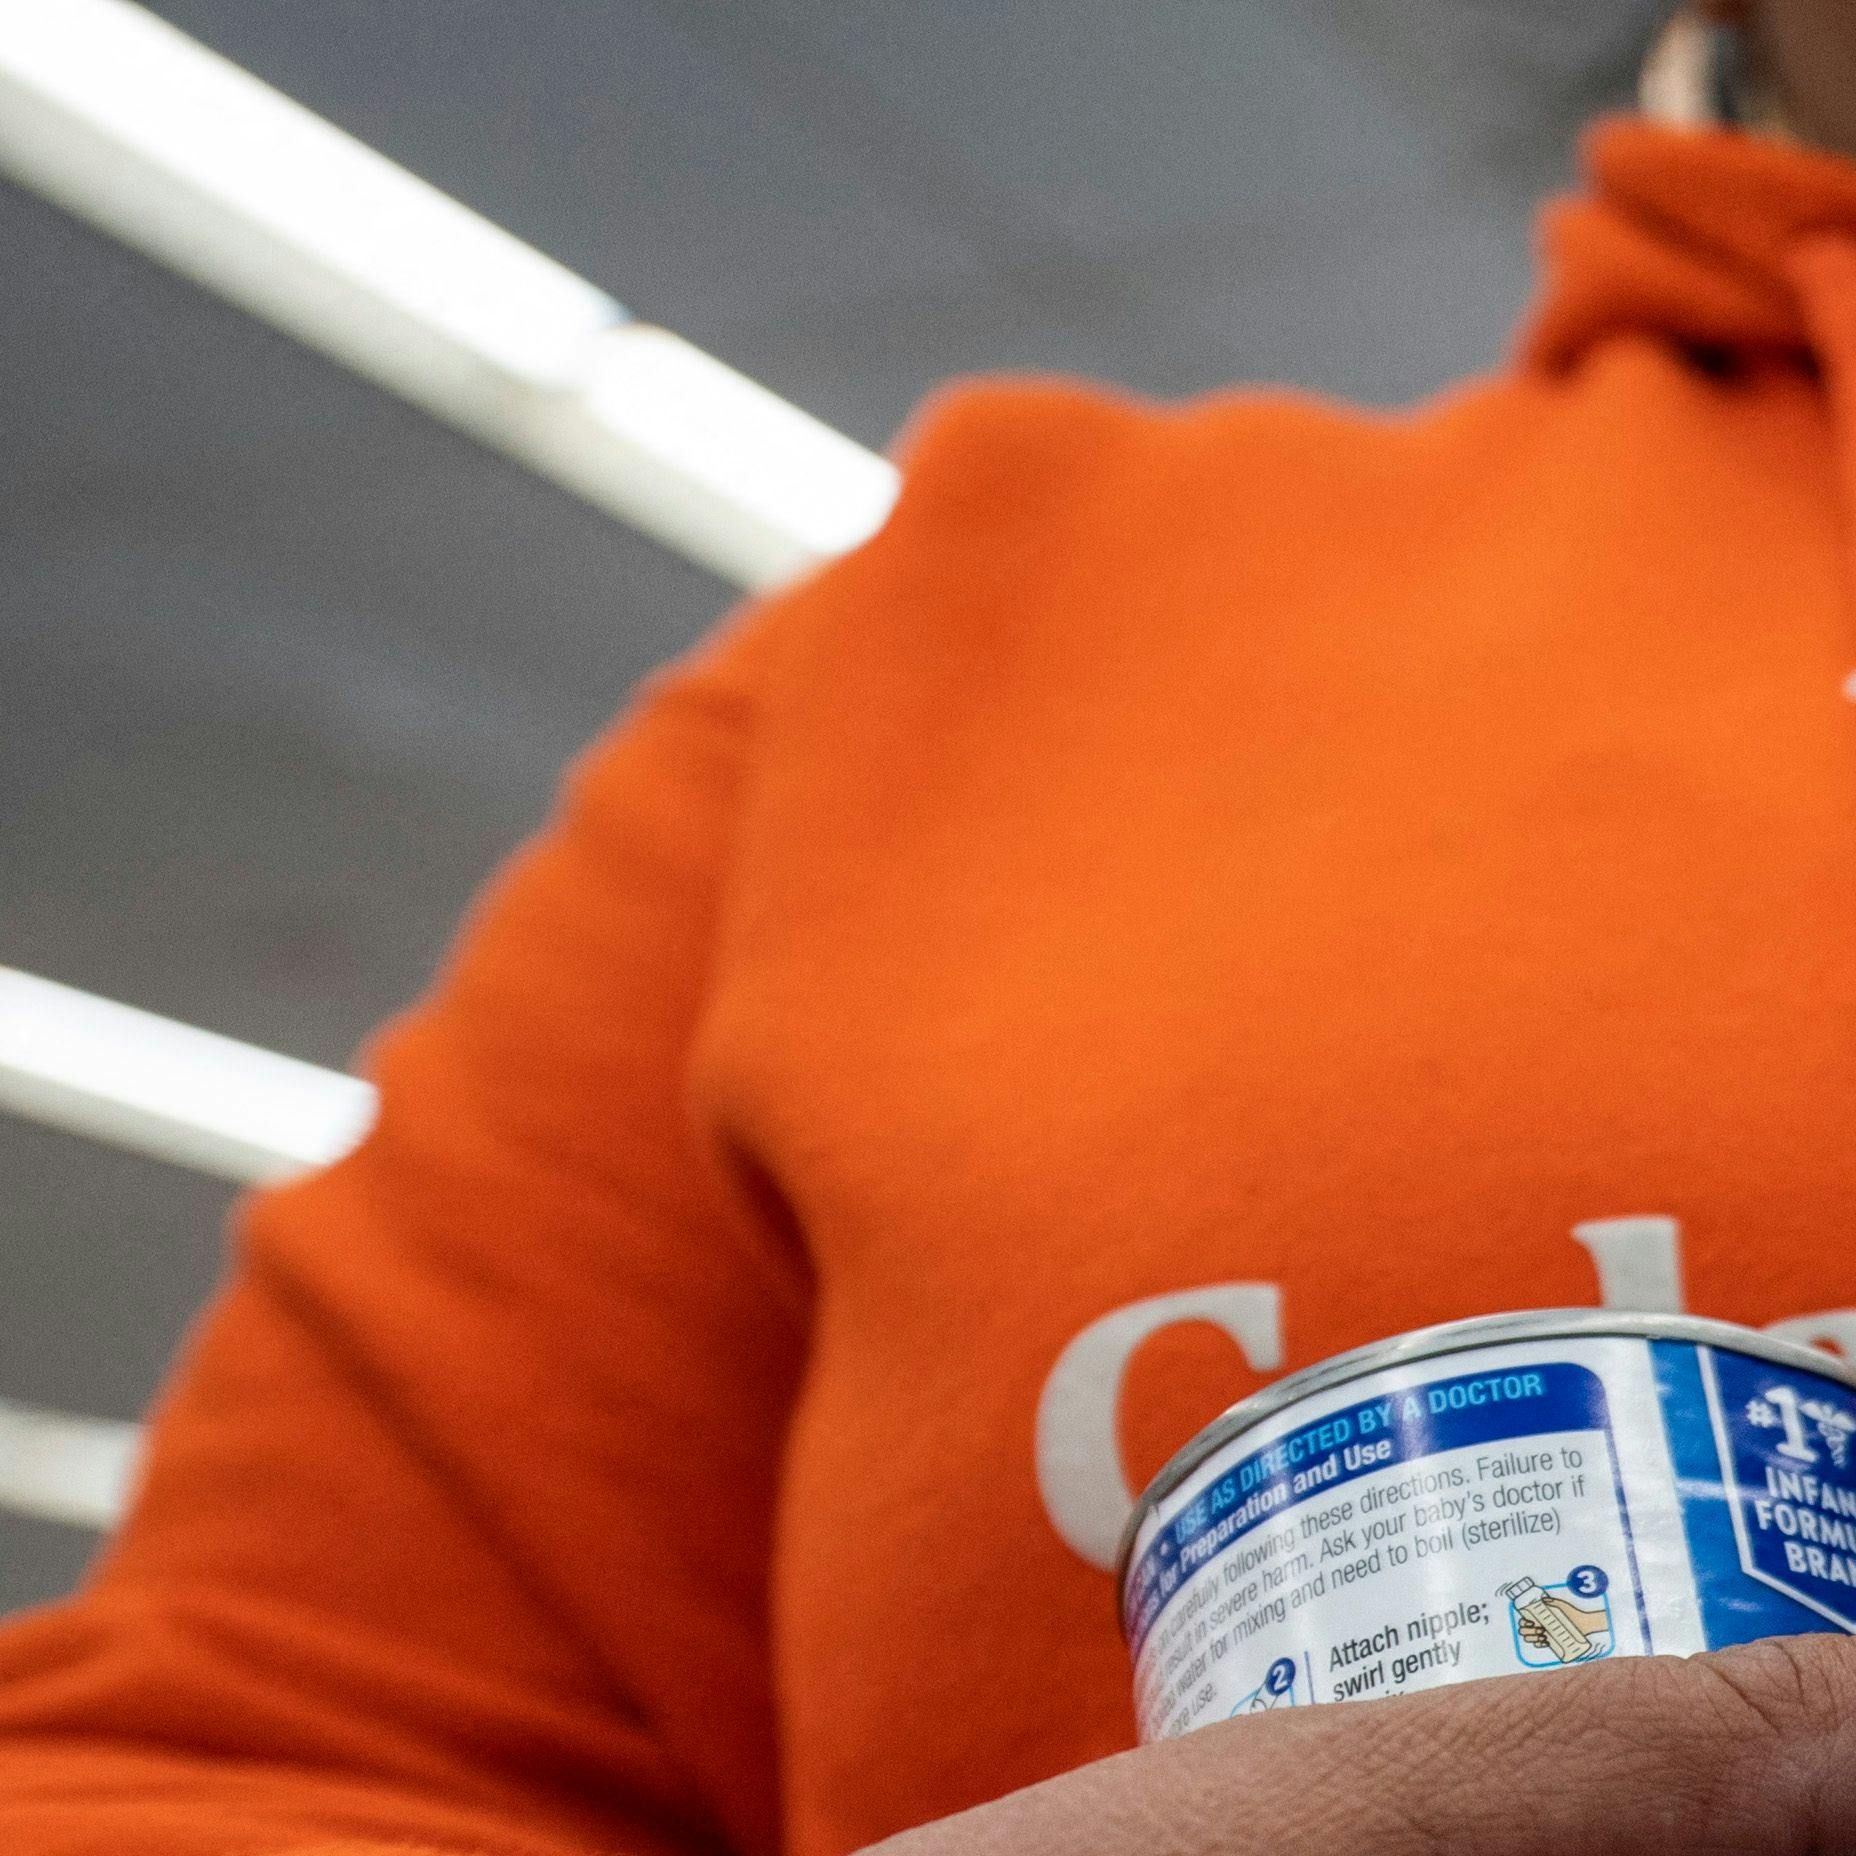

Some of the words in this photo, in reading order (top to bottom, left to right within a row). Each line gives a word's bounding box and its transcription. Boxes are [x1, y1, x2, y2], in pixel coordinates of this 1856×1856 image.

[1174, 1496, 1210, 1545] USE
[1210, 1476, 1237, 1514] AS
[1239, 1418, 1351, 1494] DIRECTED
[1357, 1401, 1393, 1435] BY
[1402, 1395, 1422, 1422] A
[1427, 1372, 1545, 1416] DOCTOR
[1179, 1481, 1288, 1575] Preparation
[1293, 1451, 1338, 1495] and
[1342, 1437, 1392, 1472] Use
[1222, 1527, 1295, 1587] following
[1300, 1502, 1353, 1540] these
[1360, 1467, 1471, 1514] directions.
[1476, 1448, 1553, 1482] Failure
[1561, 1446, 1583, 1469] to
[1209, 1581, 1258, 1632] severe
[1262, 1552, 1314, 1589] harm.
[1319, 1528, 1356, 1564] Ask
[1361, 1511, 1407, 1551] your
[1414, 1490, 1486, 1528] baby's
[1492, 1478, 1564, 1509] doctor
[1572, 1474, 1585, 1499] if
[1209, 1630, 1229, 1665] for
[1233, 1595, 1286, 1643] mixing
[1291, 1576, 1326, 1610] and
[1331, 1553, 1381, 1591] need
[1386, 1541, 1408, 1567] to
[1414, 1527, 1455, 1559] boil
[1461, 1506, 1561, 1551] (sterilize)
[1578, 1569, 1598, 1594] 3
[1328, 1623, 1400, 1674] Attach
[1406, 1599, 1492, 1639] nipple;
[1332, 1660, 1386, 1704] swirl
[1391, 1639, 1463, 1685] gently
